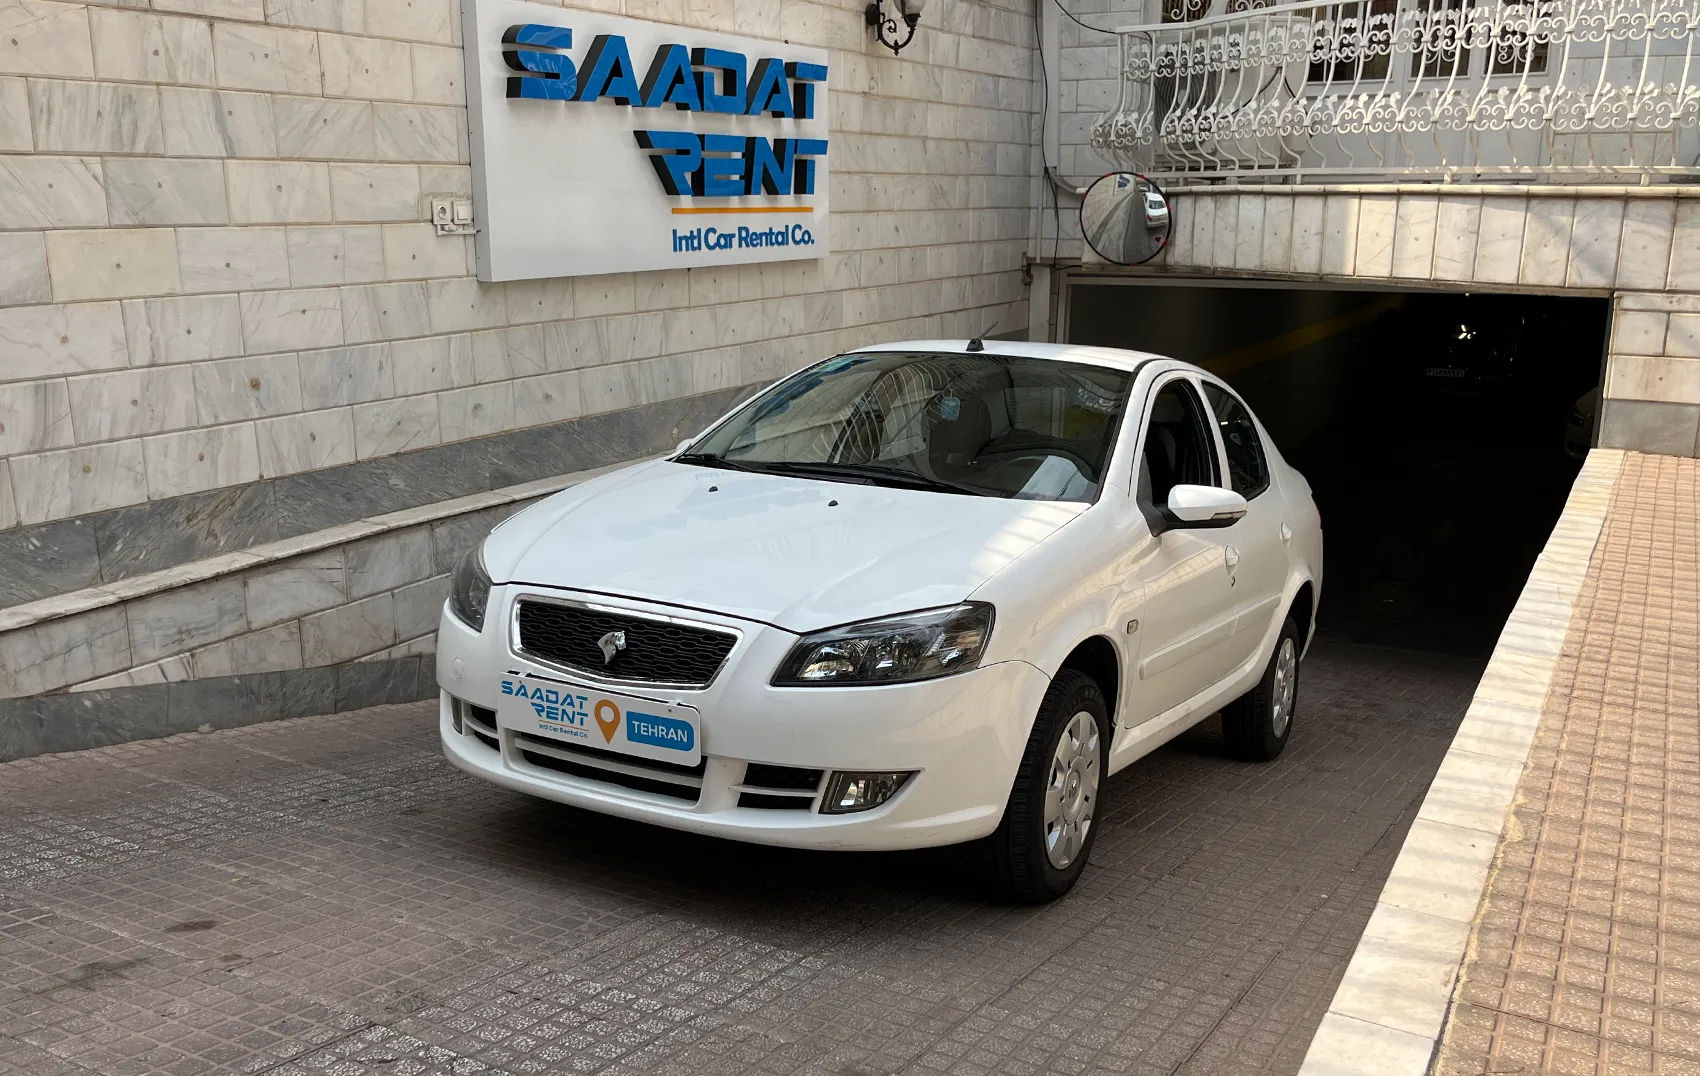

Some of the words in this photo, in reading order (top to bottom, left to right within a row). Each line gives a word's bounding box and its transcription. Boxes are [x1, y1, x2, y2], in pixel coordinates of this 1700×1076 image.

[502, 24, 828, 119] SAADAT
[634, 130, 828, 196] RENT
[672, 228, 702, 252] Intl
[704, 227, 736, 250] Car
[738, 224, 789, 248] Rental
[791, 223, 815, 245] Co.
[501, 680, 589, 710] SAADAT
[531, 702, 589, 726] RENT
[559, 727, 579, 737] Rental
[632, 720, 688, 743] TEHRAN
